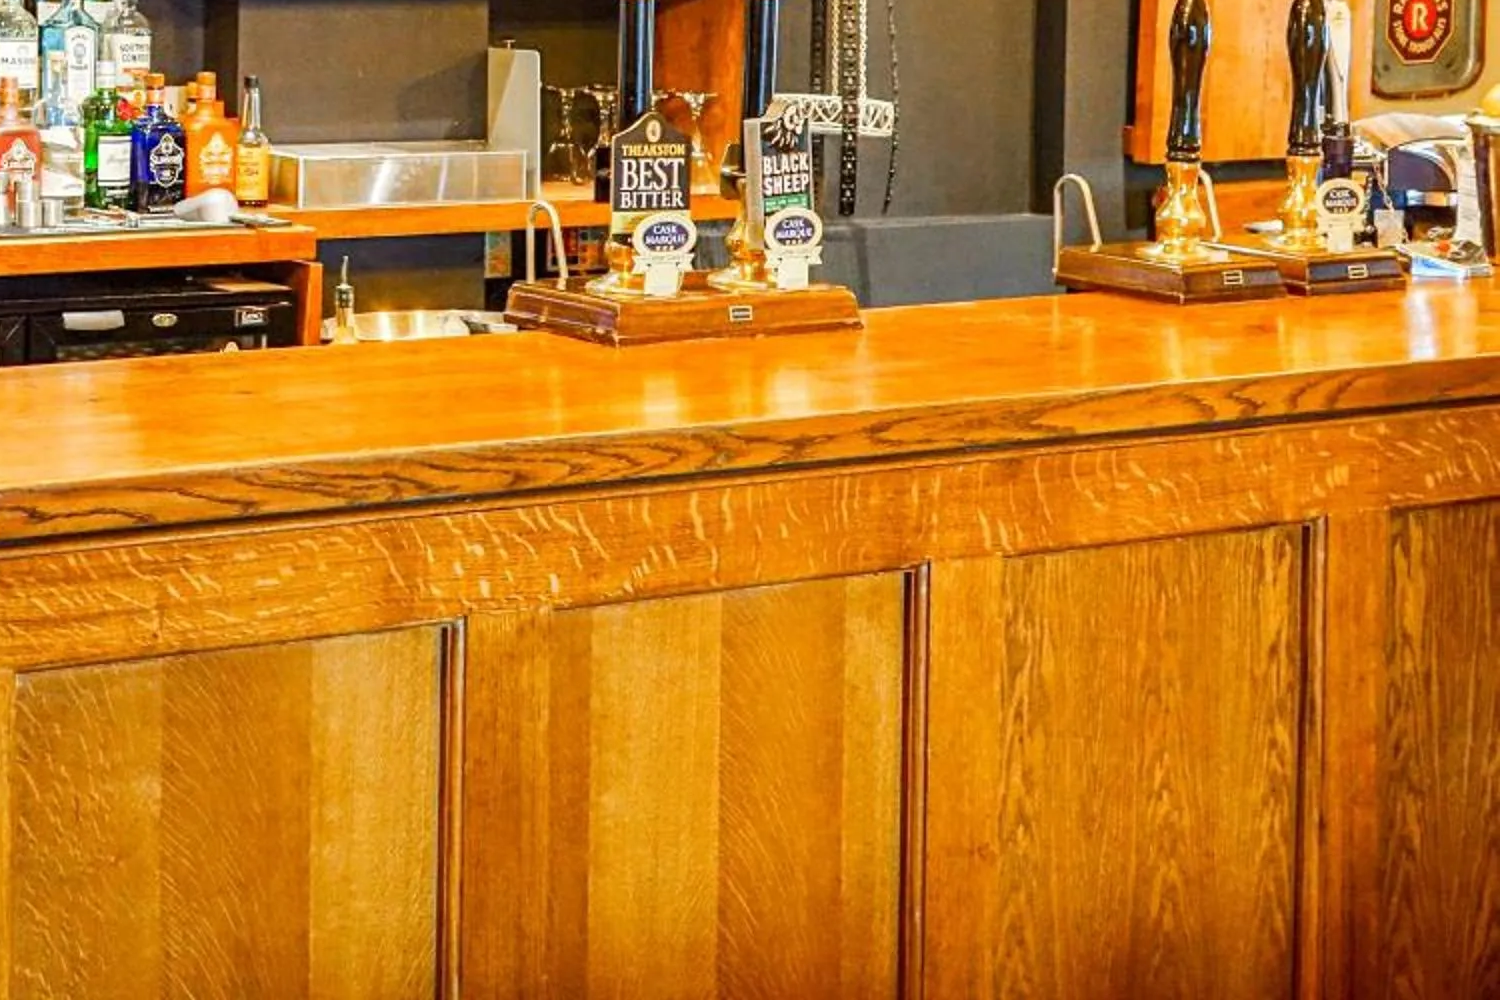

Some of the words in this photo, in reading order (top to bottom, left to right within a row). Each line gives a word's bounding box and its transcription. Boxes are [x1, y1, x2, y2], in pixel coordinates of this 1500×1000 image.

[1411, 2, 1430, 32] R
[622, 144, 685, 156] THEAKSTON
[763, 152, 809, 175] BLACK
[620, 158, 685, 190] BEST
[764, 172, 810, 196] SHEEP
[620, 191, 685, 209] BITTER
[653, 225, 677, 235] CASK
[782, 218, 805, 228] CASK
